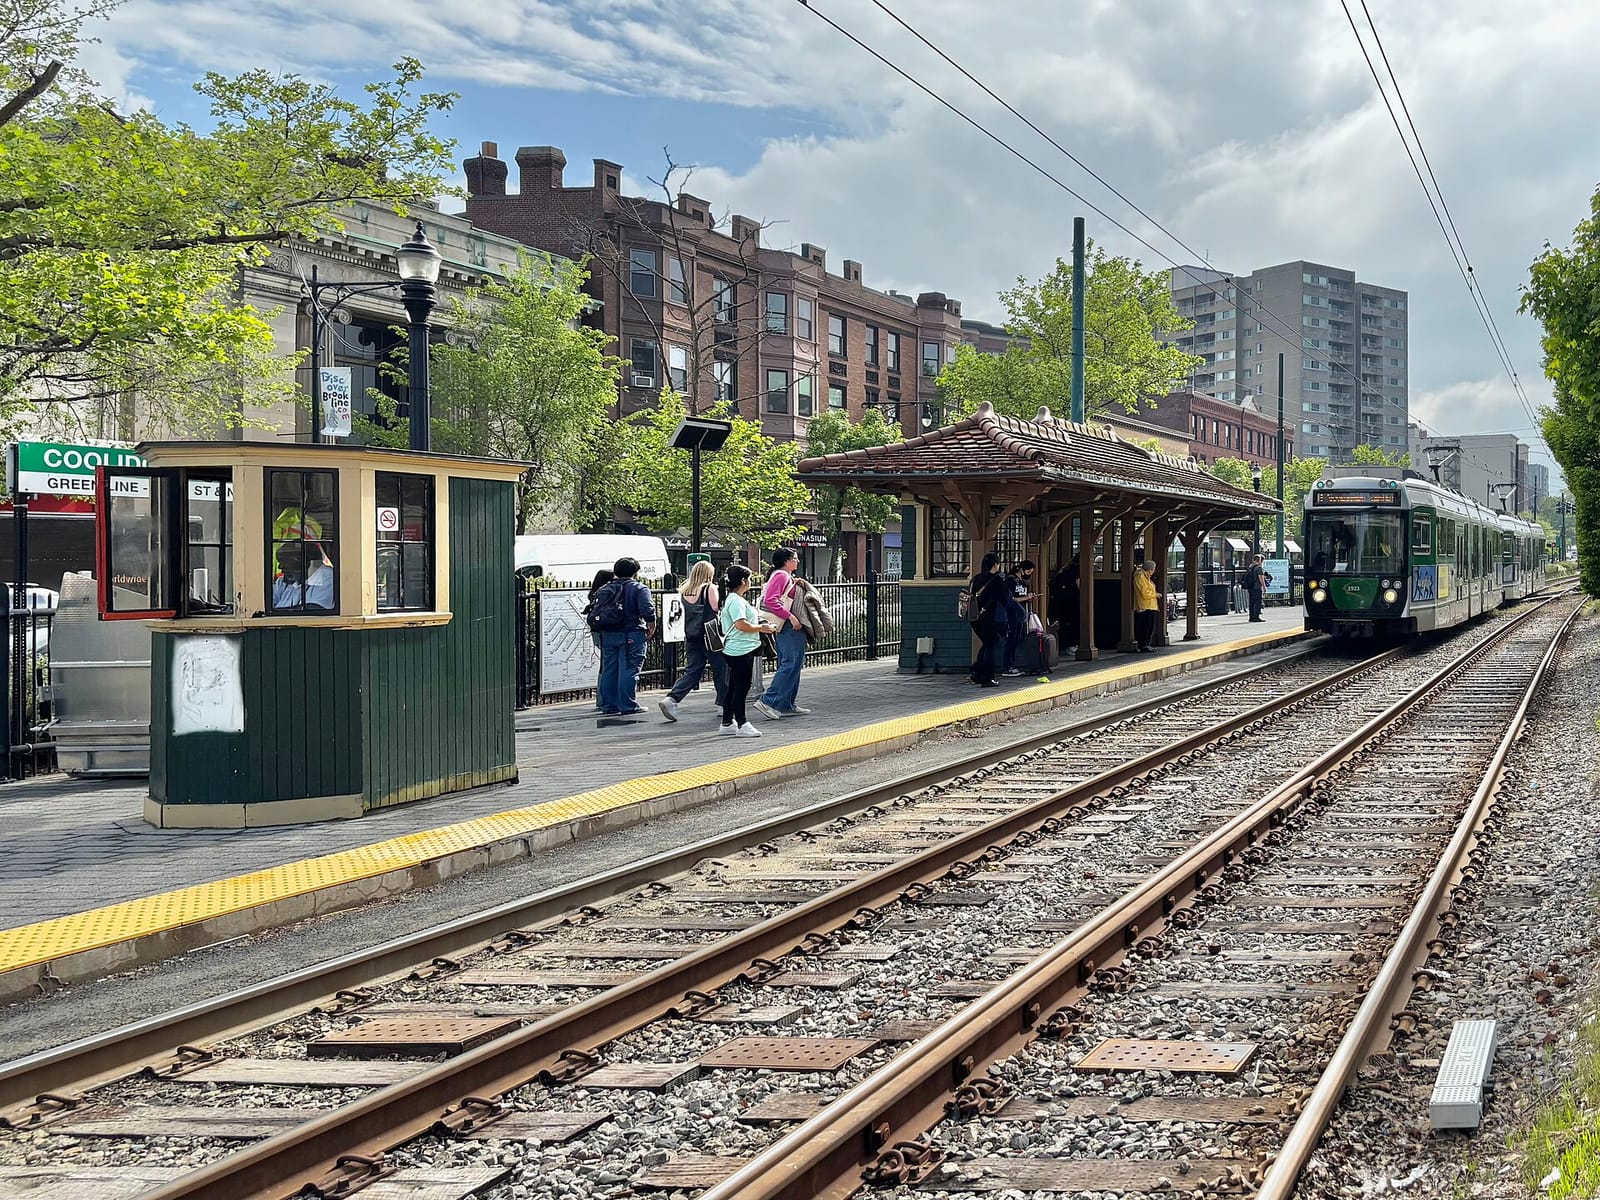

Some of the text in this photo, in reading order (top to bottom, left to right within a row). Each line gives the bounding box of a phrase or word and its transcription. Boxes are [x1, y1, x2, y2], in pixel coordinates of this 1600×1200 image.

[320, 371, 345, 384] Disc
[327, 383, 348, 392] over
[322, 391, 349, 401] Brook
[331, 397, 349, 408] line
[110, 481, 139, 493] INE
[194, 485, 211, 496] ST
